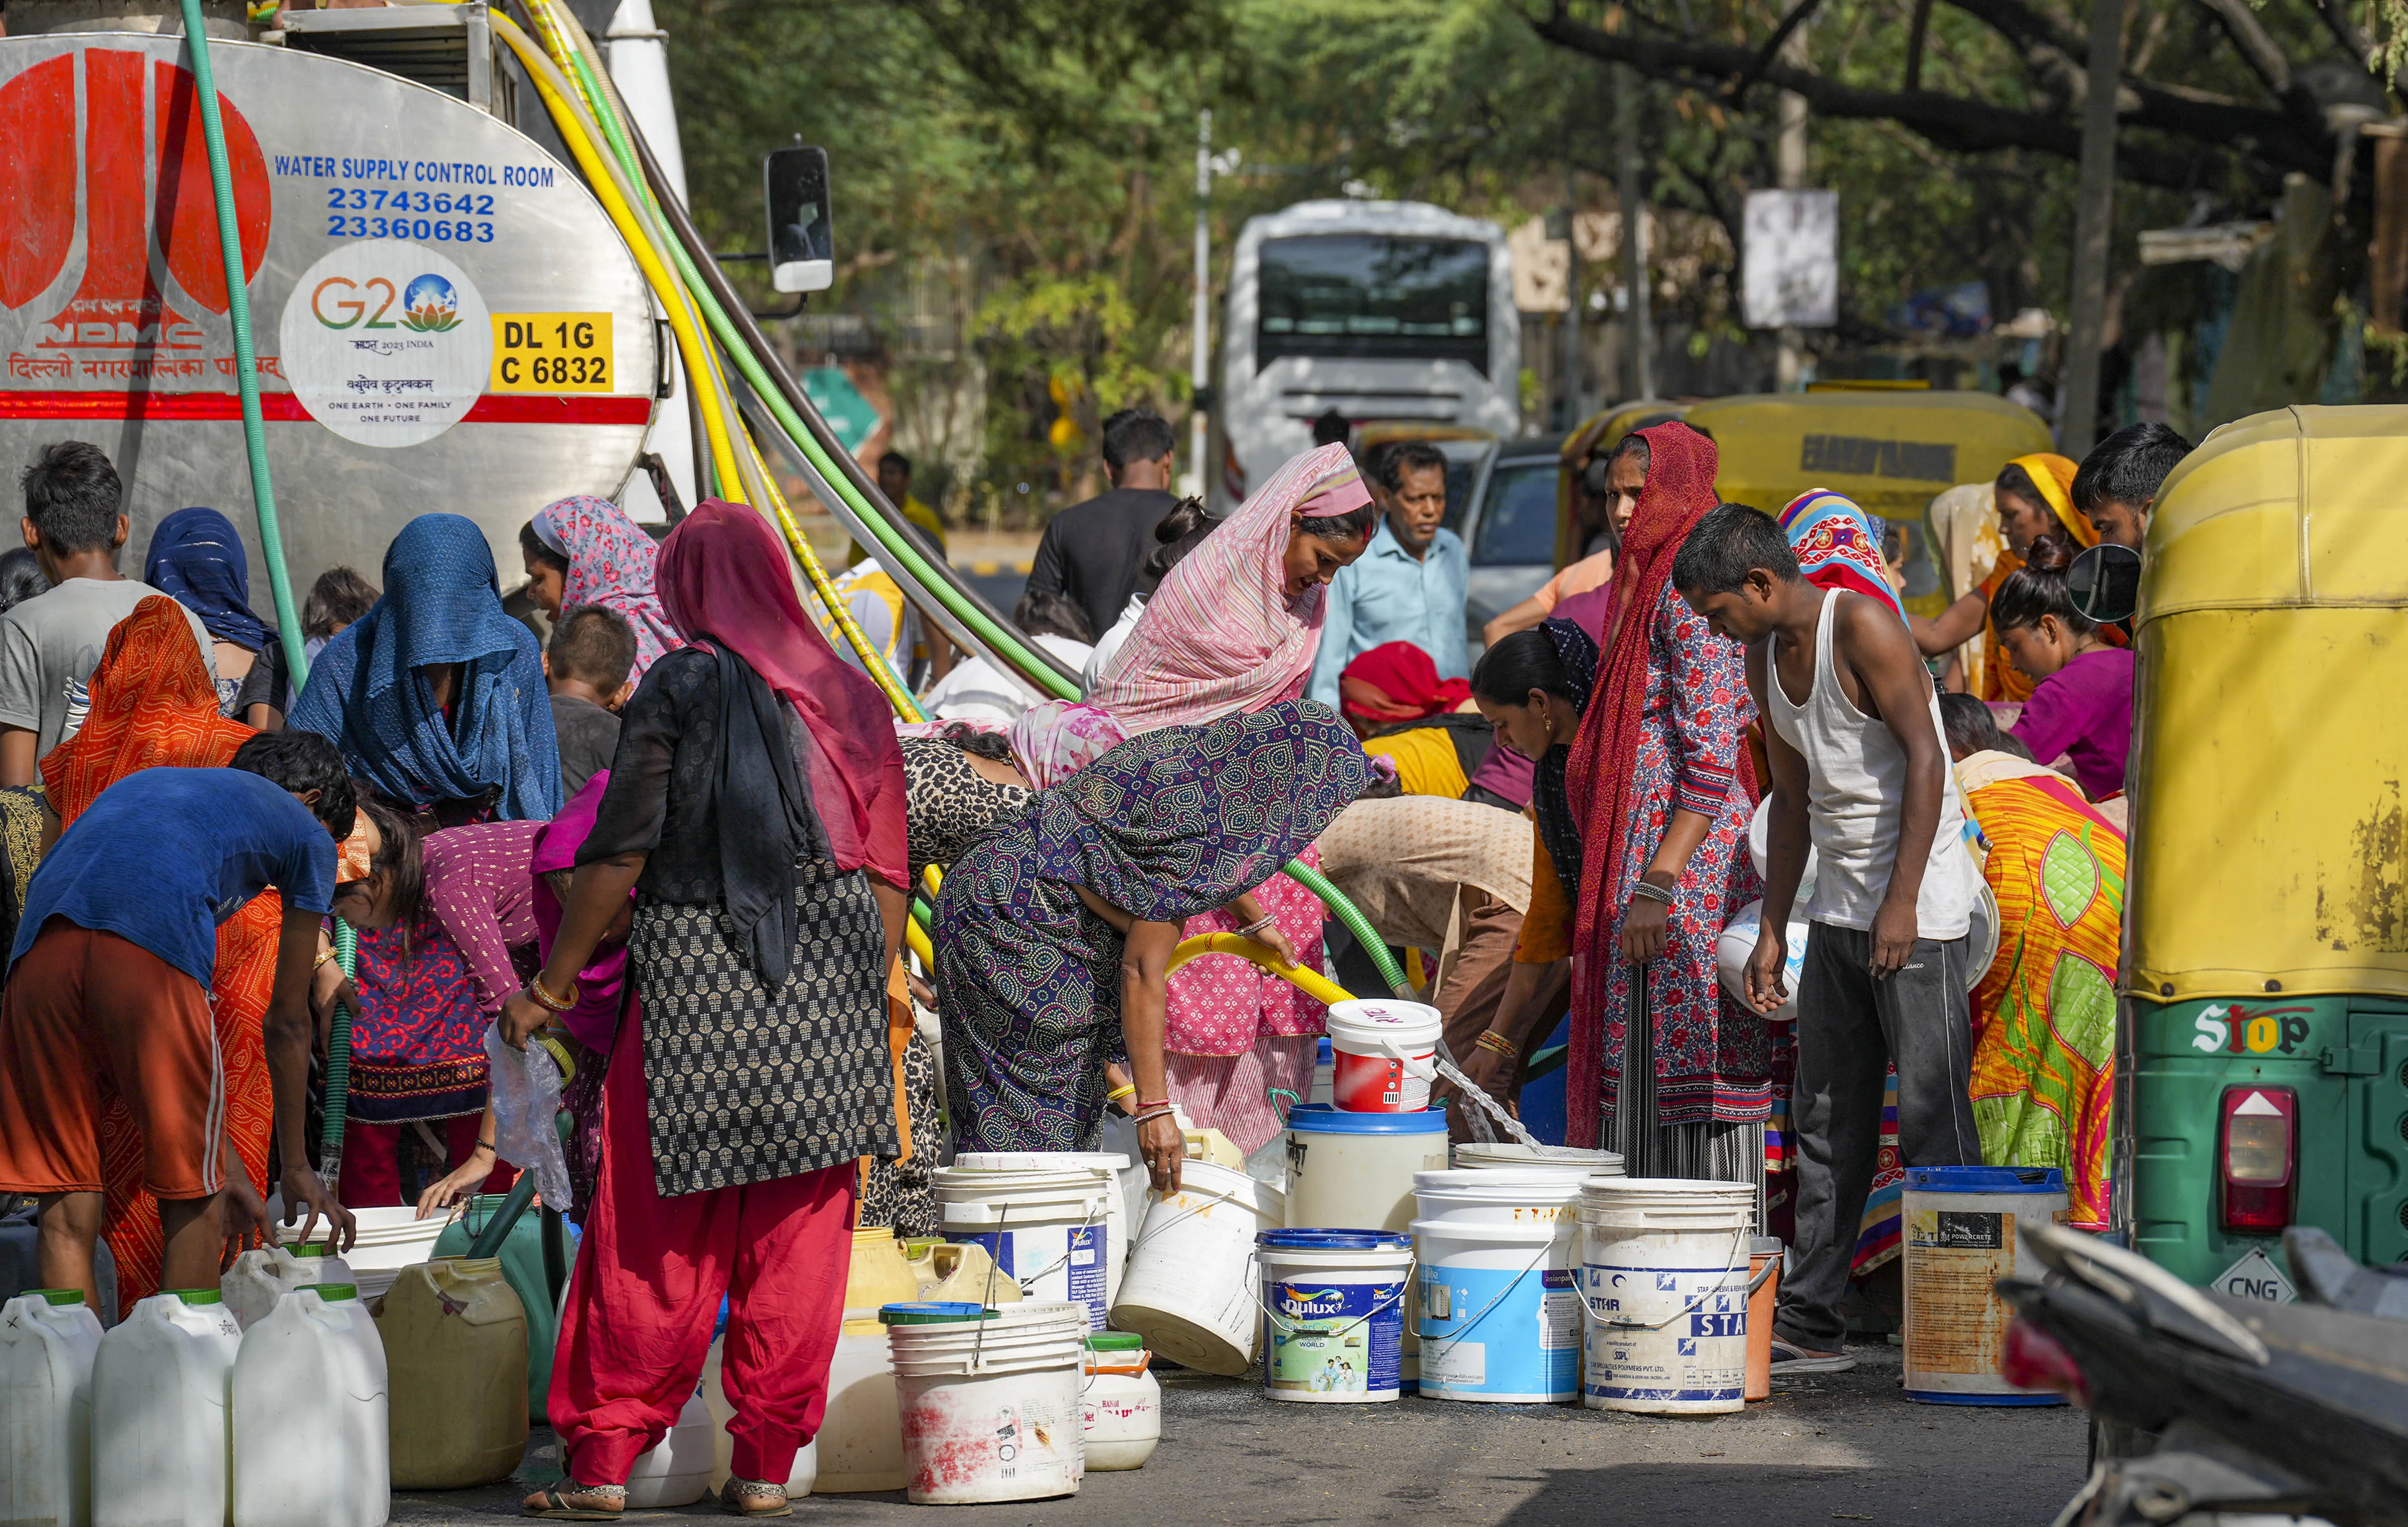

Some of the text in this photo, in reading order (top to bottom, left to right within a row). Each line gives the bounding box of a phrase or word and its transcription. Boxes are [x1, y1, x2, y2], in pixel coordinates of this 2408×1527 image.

[274, 155, 553, 188] WATER SUPPLY CONTROL ROOM
[327, 188, 494, 215] 23743642
[327, 215, 494, 243] 23360683
[39, 322, 205, 343] NDMC
[505, 322, 593, 349] DL 1G
[382, 342, 404, 350] 2023
[6, 352, 75, 380] दिल्ली
[80, 352, 207, 380] नगरपालिका
[502, 357, 606, 383] C 6832
[381, 380, 433, 394] कुटुम्बकम्
[2192, 1004, 2314, 1054] Stop
[1939, 1234, 1950, 1242] 304
[1546, 1275, 1575, 1284] asianpais
[2228, 1277, 2278, 1302] CNG
[1284, 1299, 1336, 1314] Dulux
[1590, 1296, 1619, 1311] STAR
[1701, 1314, 1748, 1336] STA
